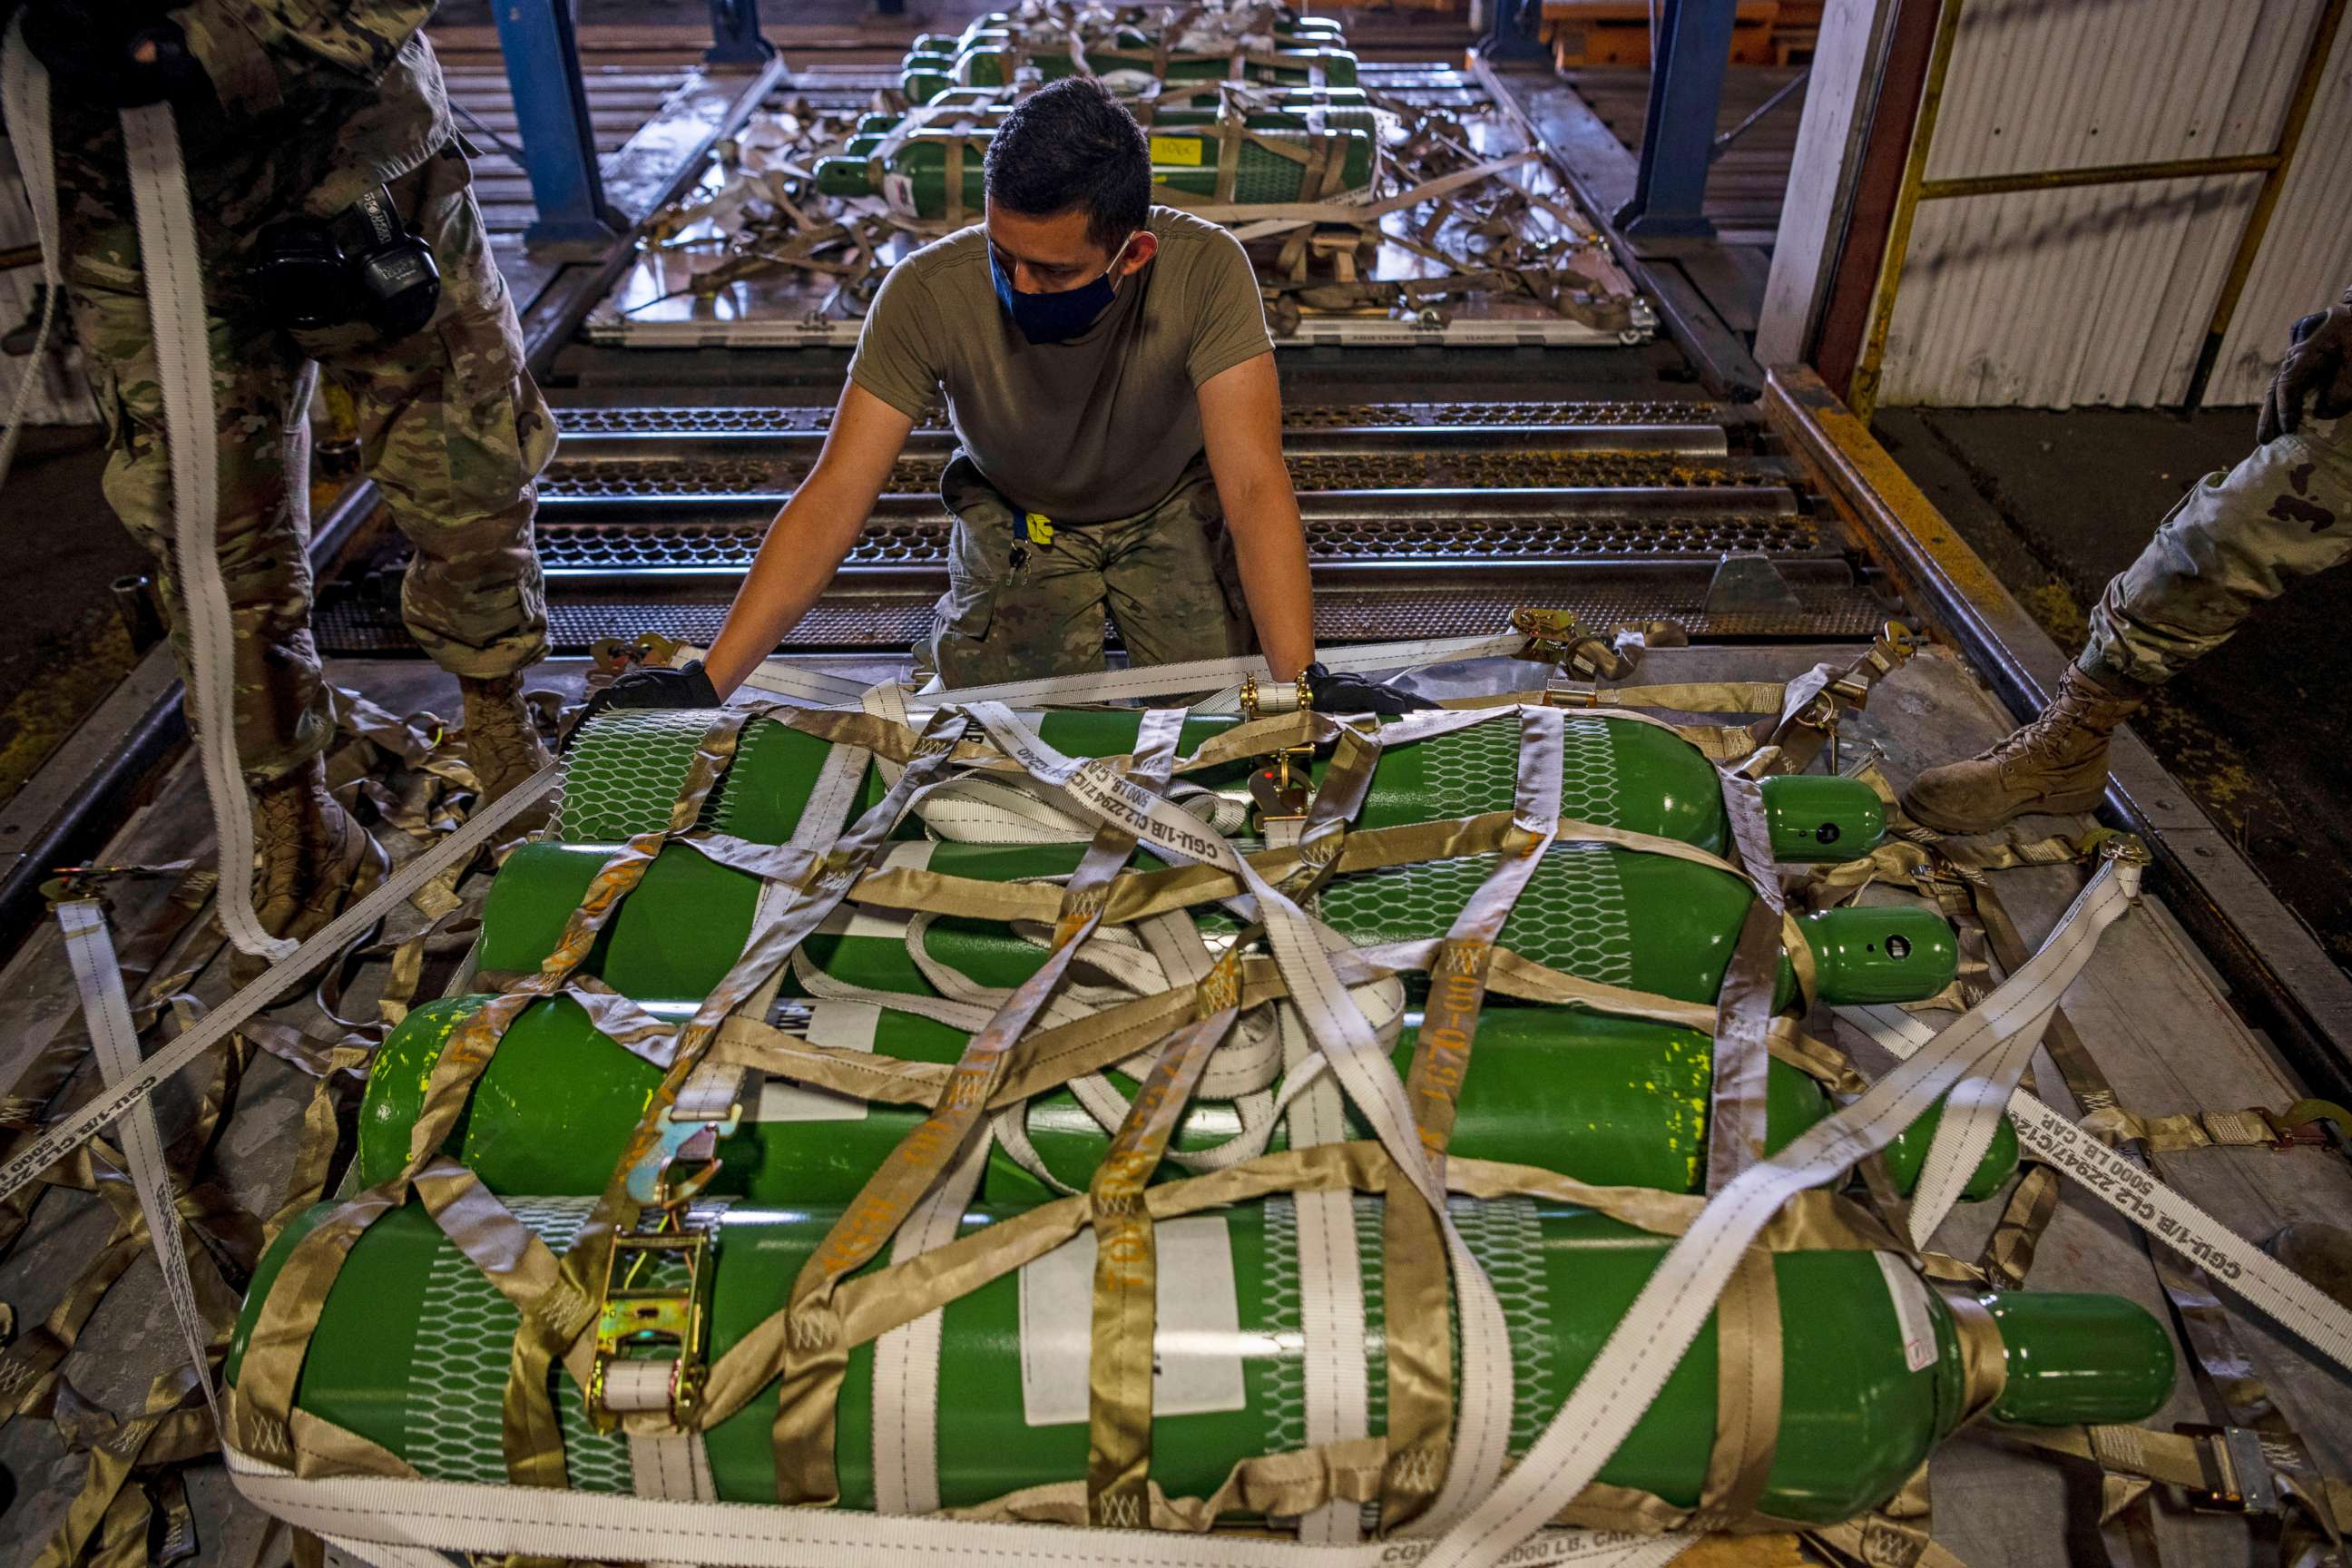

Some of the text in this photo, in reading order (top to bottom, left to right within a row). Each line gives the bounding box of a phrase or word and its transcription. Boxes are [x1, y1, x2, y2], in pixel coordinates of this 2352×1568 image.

[1126, 784, 1151, 808] 5000
[1124, 808, 1148, 831] CL2
[1152, 818, 1218, 859] CGU-1/B
[78, 1076, 156, 1134] CGU-1/B
[10, 1138, 54, 1173] 5000
[35, 1136, 76, 1168] CL2
[2041, 1114, 2154, 1195] 5000 LB. CAP.
[2115, 1189, 2155, 1220] CL2
[2158, 1217, 2242, 1279] CGU-1/B
[1554, 1536, 1586, 1554] LB.
